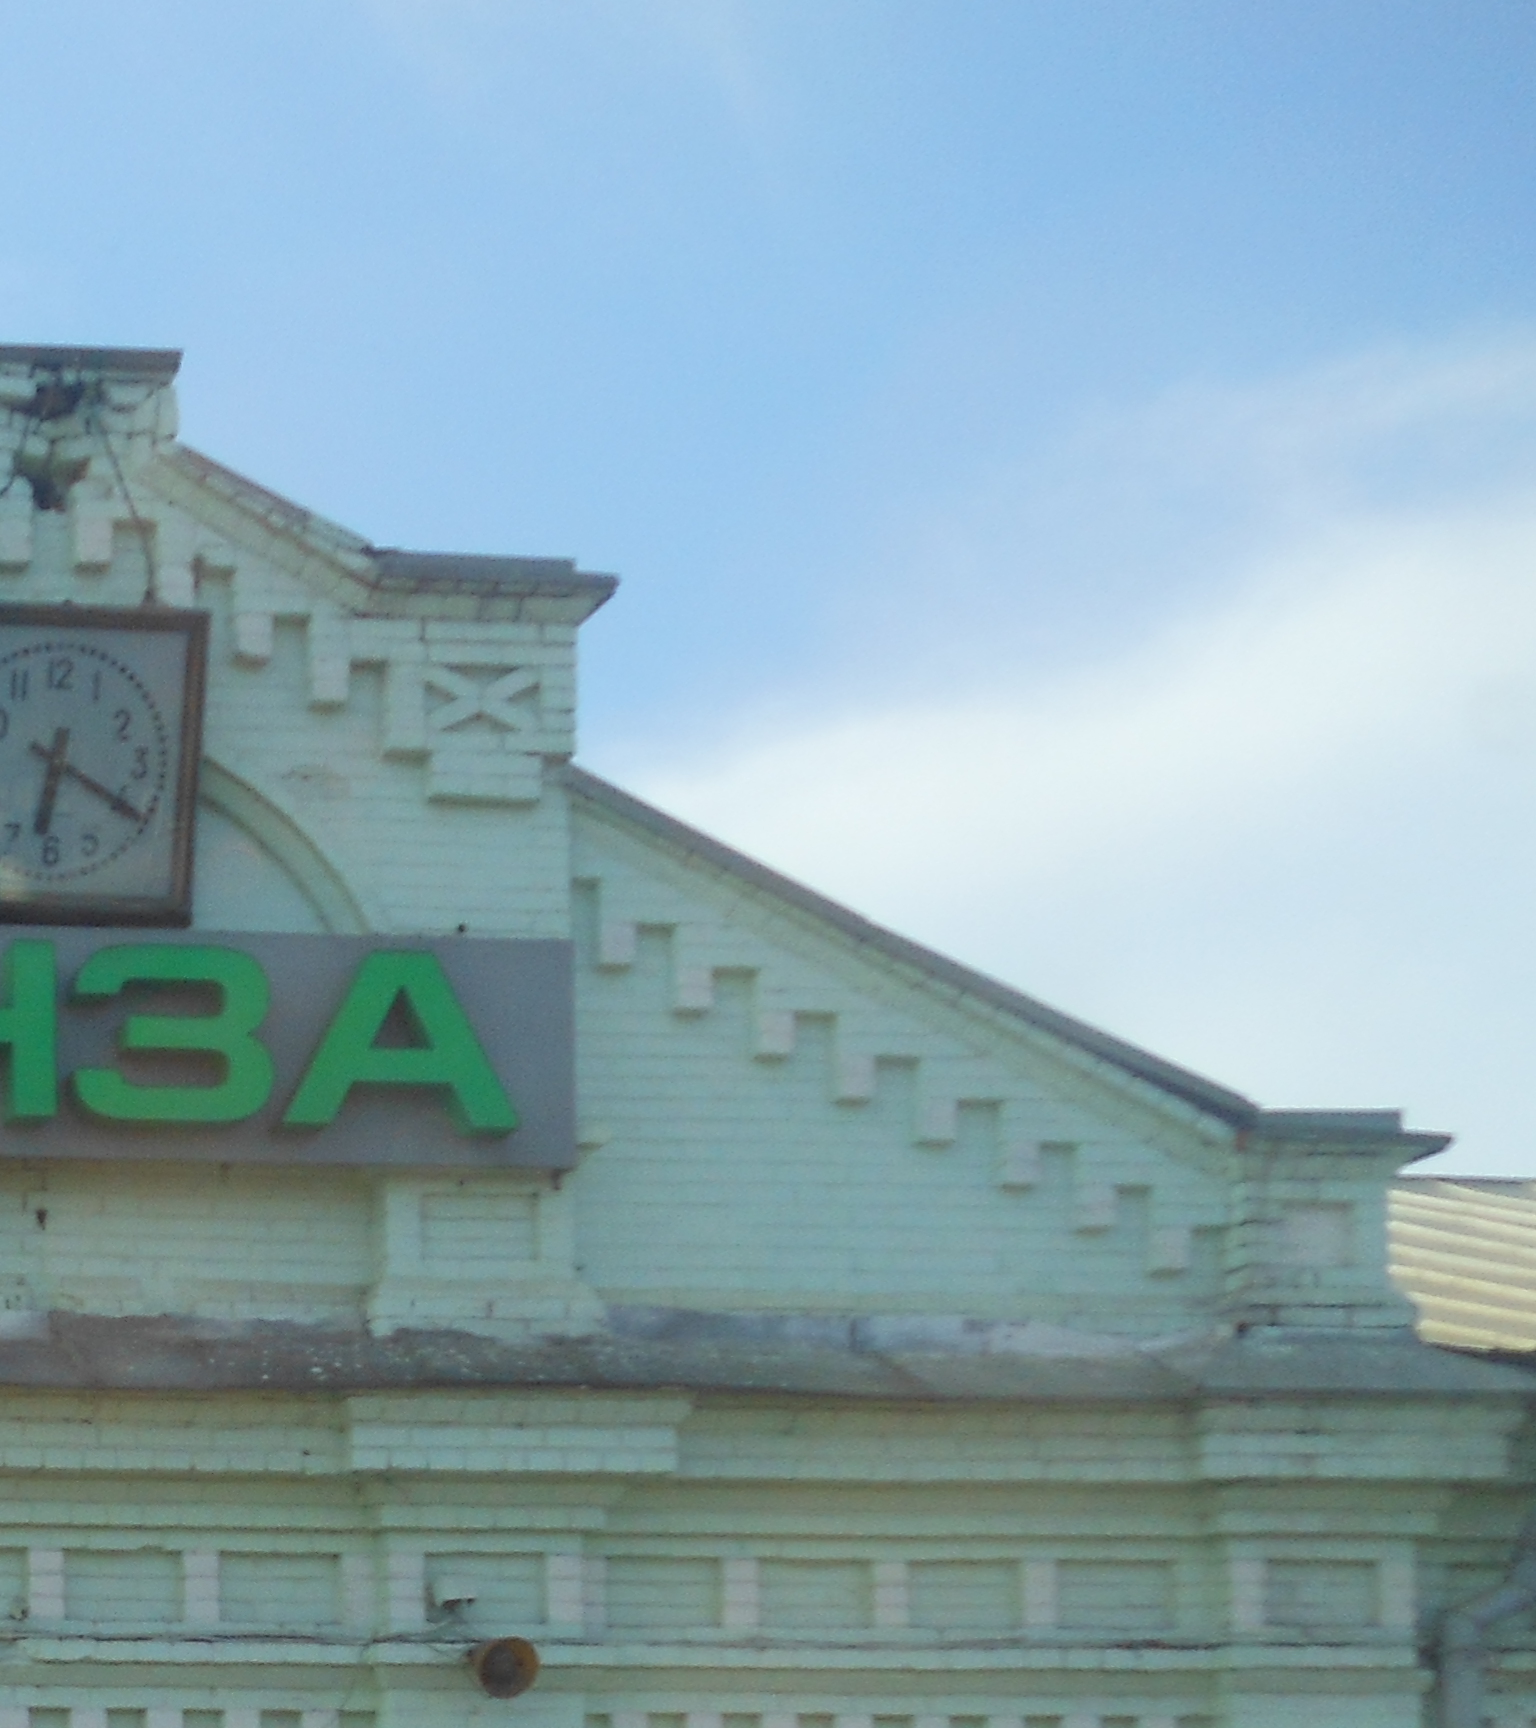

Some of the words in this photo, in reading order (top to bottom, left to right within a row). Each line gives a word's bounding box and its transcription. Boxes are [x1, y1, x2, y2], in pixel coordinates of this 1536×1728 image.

[10, 669, 29, 701] 11
[47, 657, 74, 690] 12
[92, 669, 101, 702] 1
[113, 708, 132, 742] 2
[131, 746, 149, 780] 3
[42, 834, 60, 867] 6
